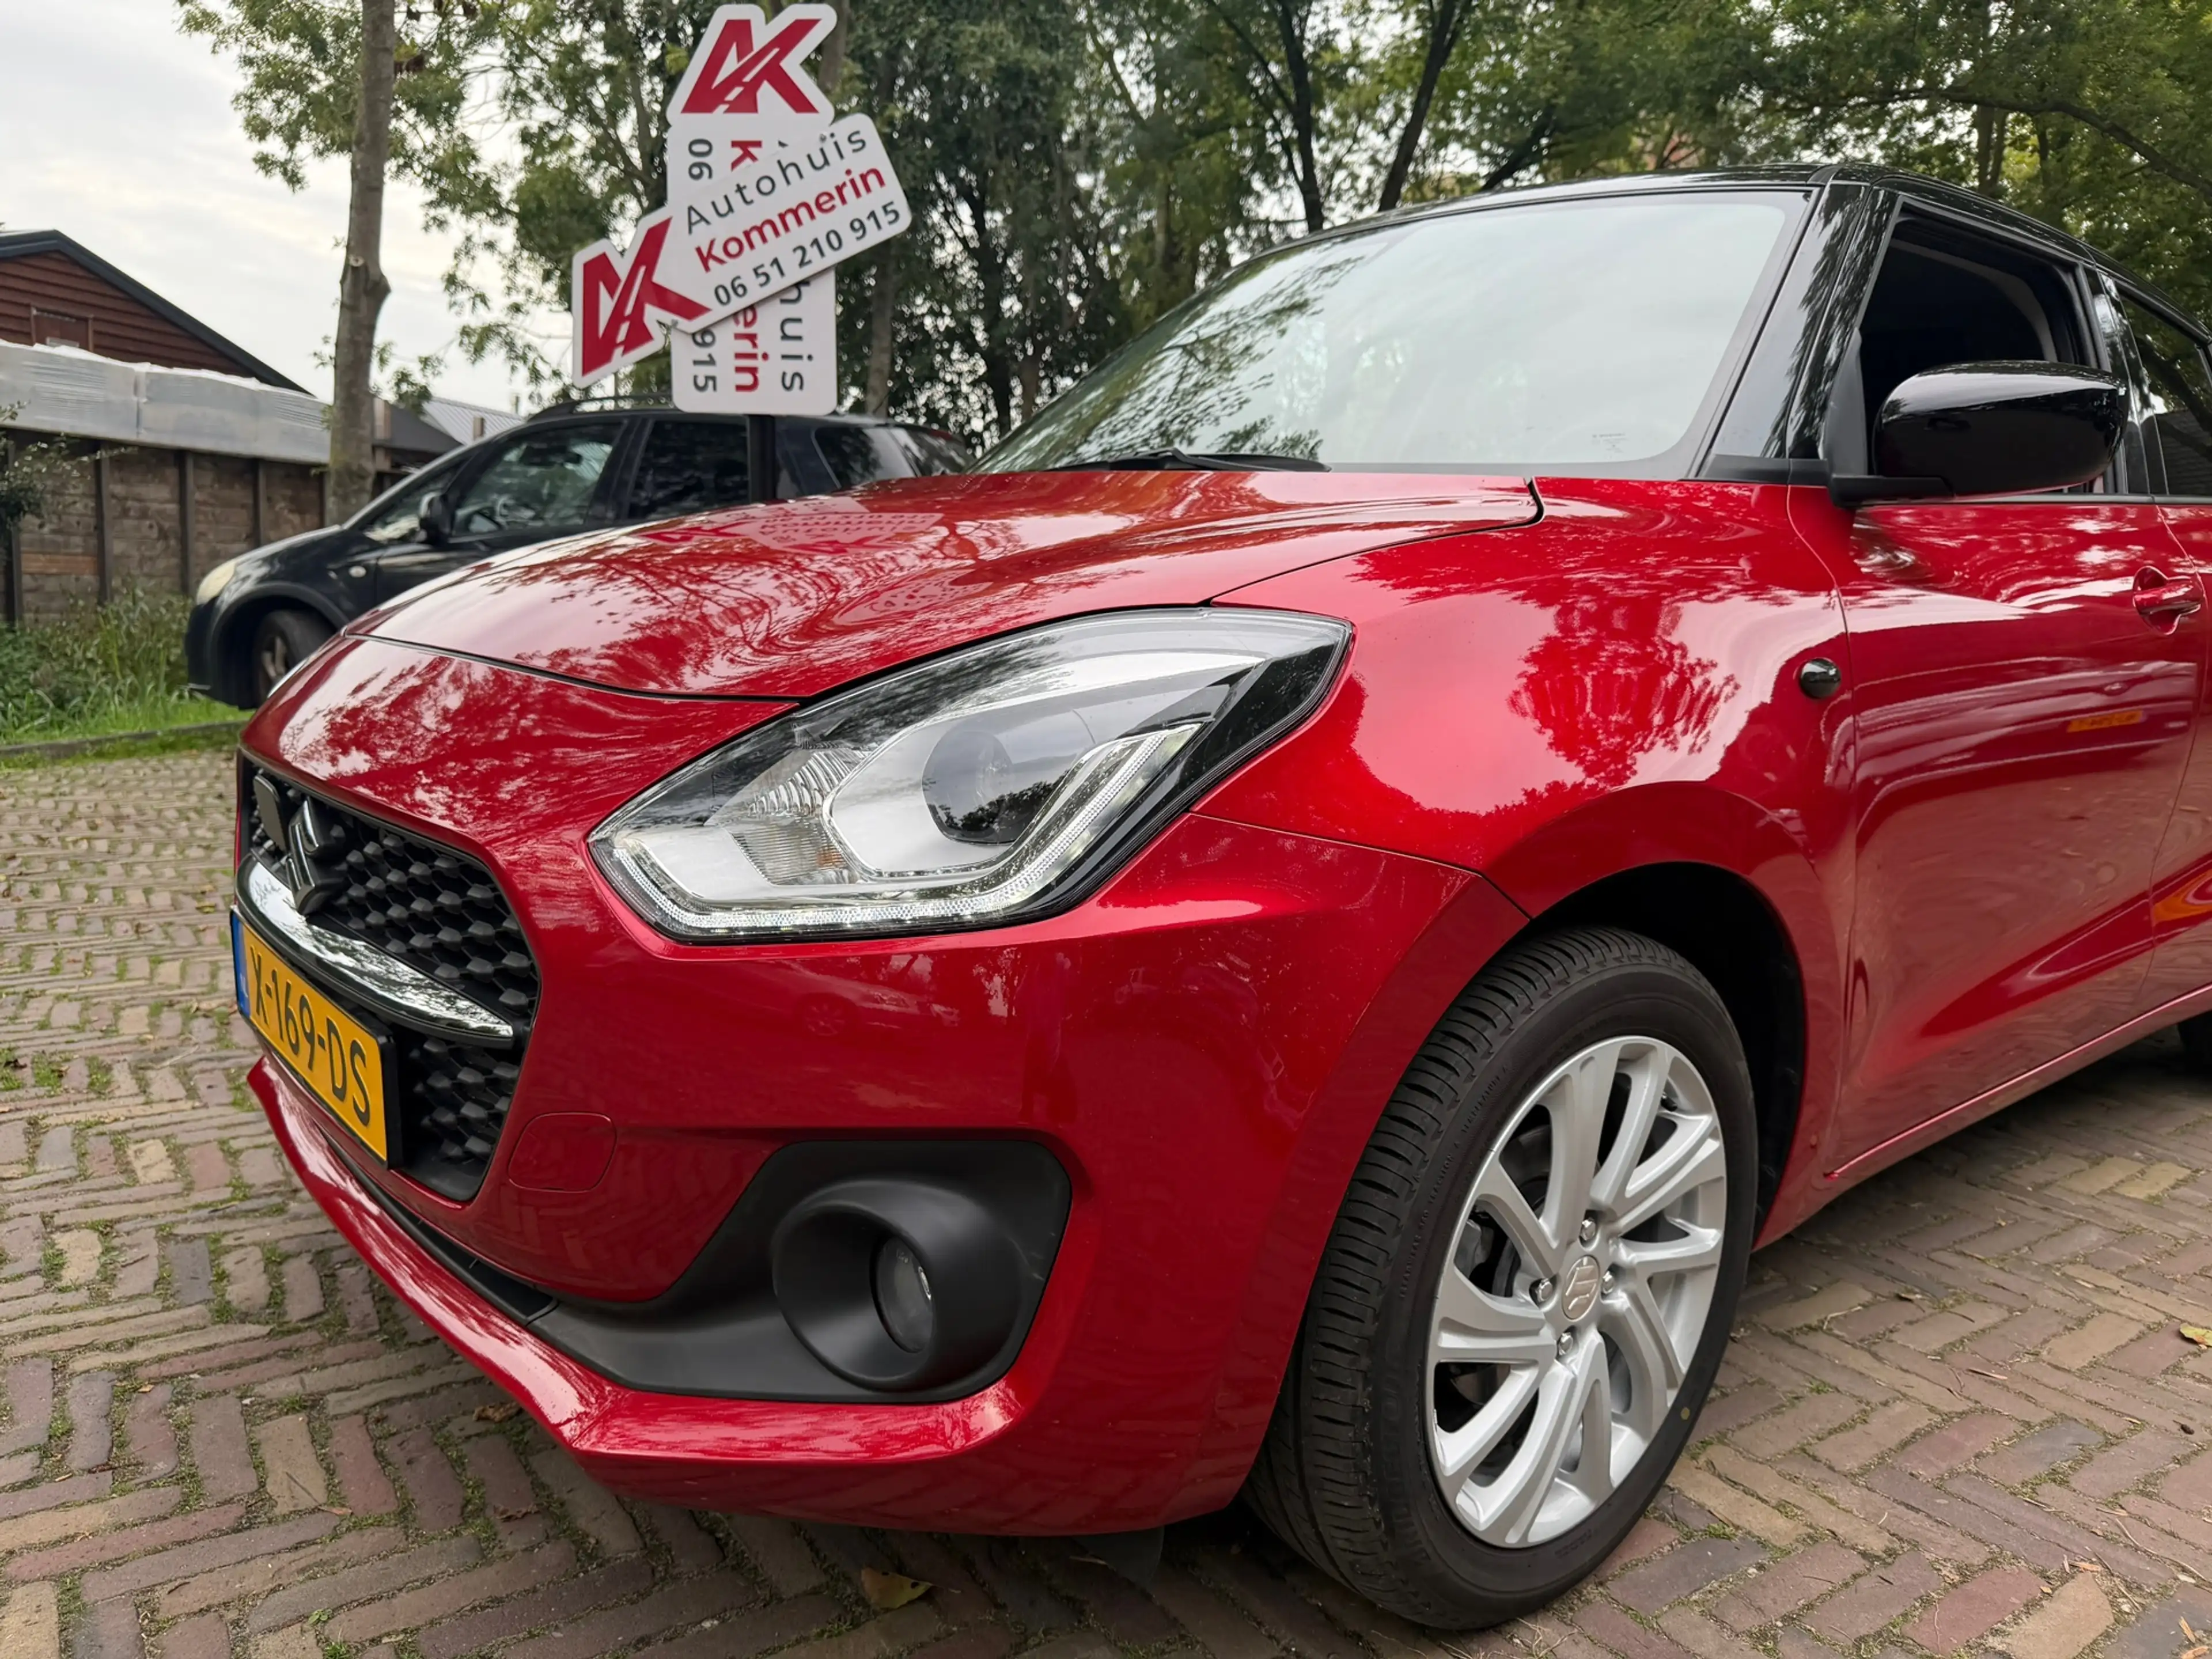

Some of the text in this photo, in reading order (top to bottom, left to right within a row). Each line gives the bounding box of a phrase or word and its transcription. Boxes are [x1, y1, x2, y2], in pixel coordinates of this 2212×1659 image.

[687, 130, 866, 235] Autohuis
[696, 168, 885, 273] Kommerin
[688, 138, 717, 392] 06 915
[714, 201, 900, 306] 06 51 210 915
[250, 945, 370, 1127] X-169-DS
